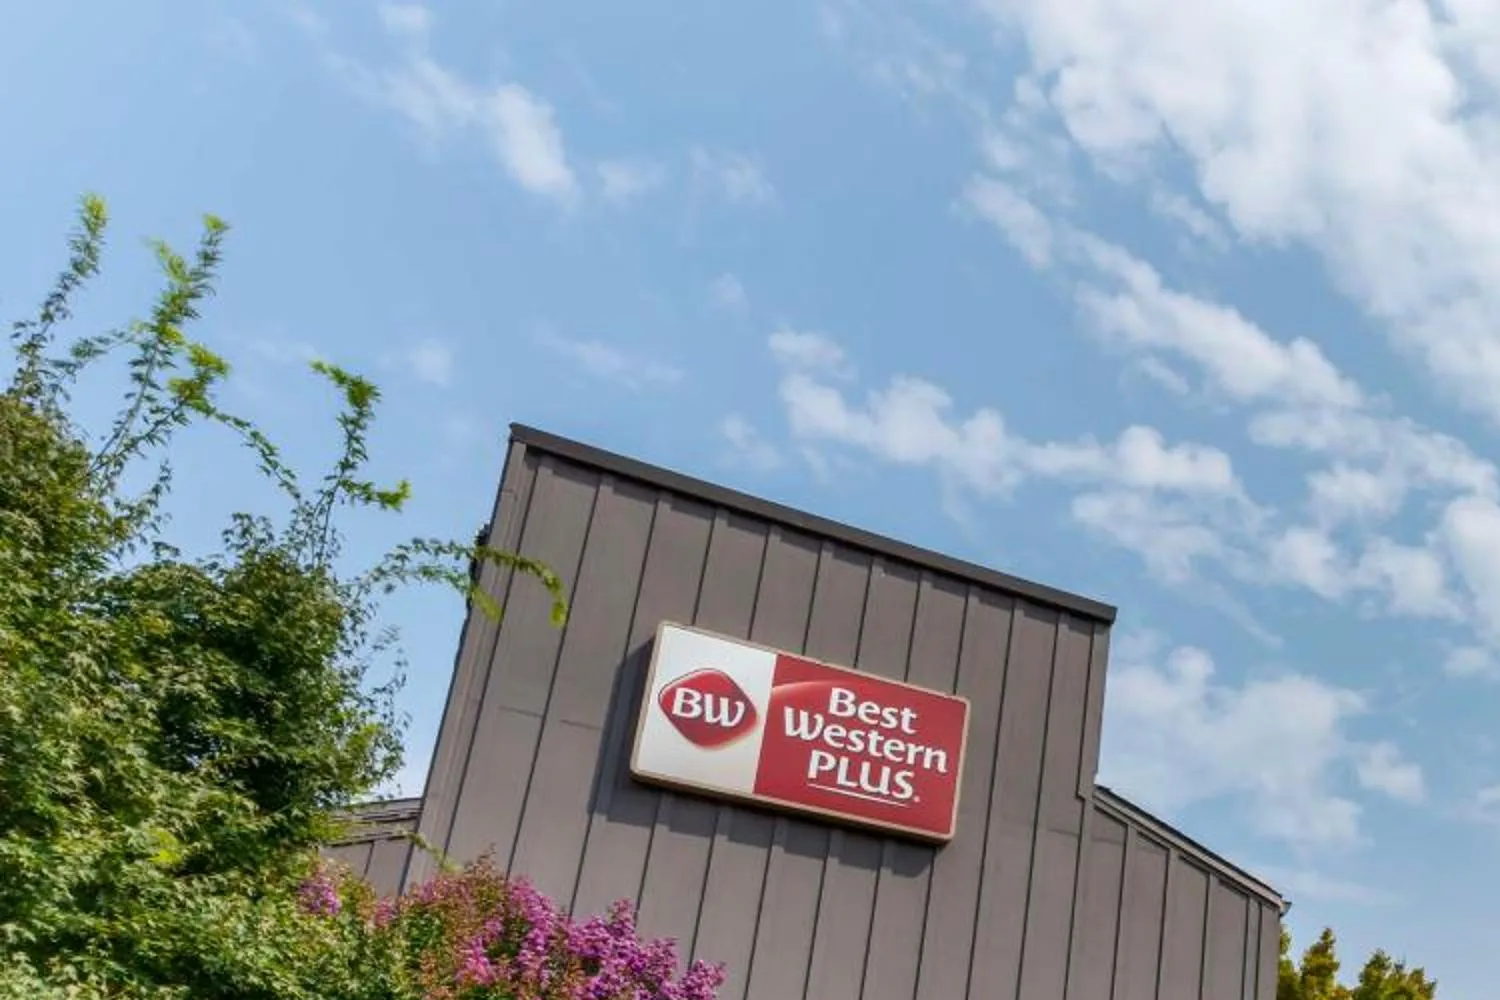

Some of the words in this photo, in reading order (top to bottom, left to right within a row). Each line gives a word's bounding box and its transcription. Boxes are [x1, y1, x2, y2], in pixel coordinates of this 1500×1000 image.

[672, 687, 745, 728] BW
[828, 687, 918, 735] Best
[784, 705, 949, 774] Western
[808, 750, 914, 800] PLUS
